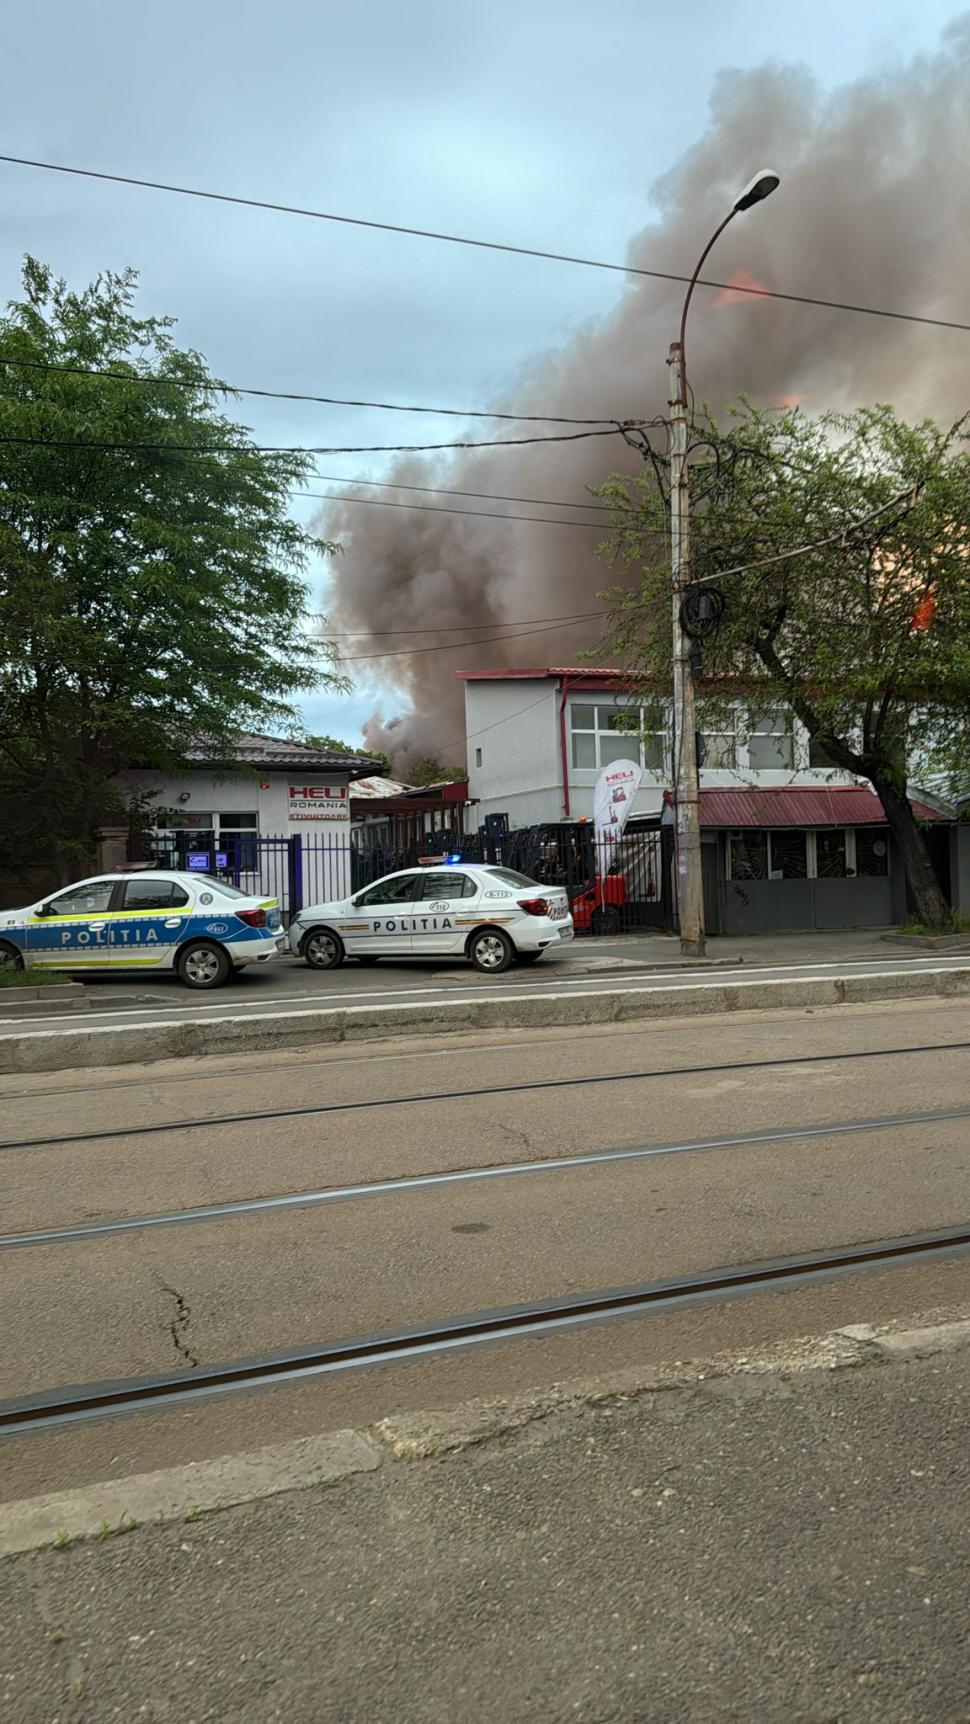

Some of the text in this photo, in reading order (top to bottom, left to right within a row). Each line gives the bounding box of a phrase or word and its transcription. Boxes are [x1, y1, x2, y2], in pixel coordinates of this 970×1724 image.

[606, 771, 633, 782] HELI
[289, 787, 346, 799] HELI
[373, 918, 452, 932] POLITIA
[61, 928, 158, 944] POLITIA
